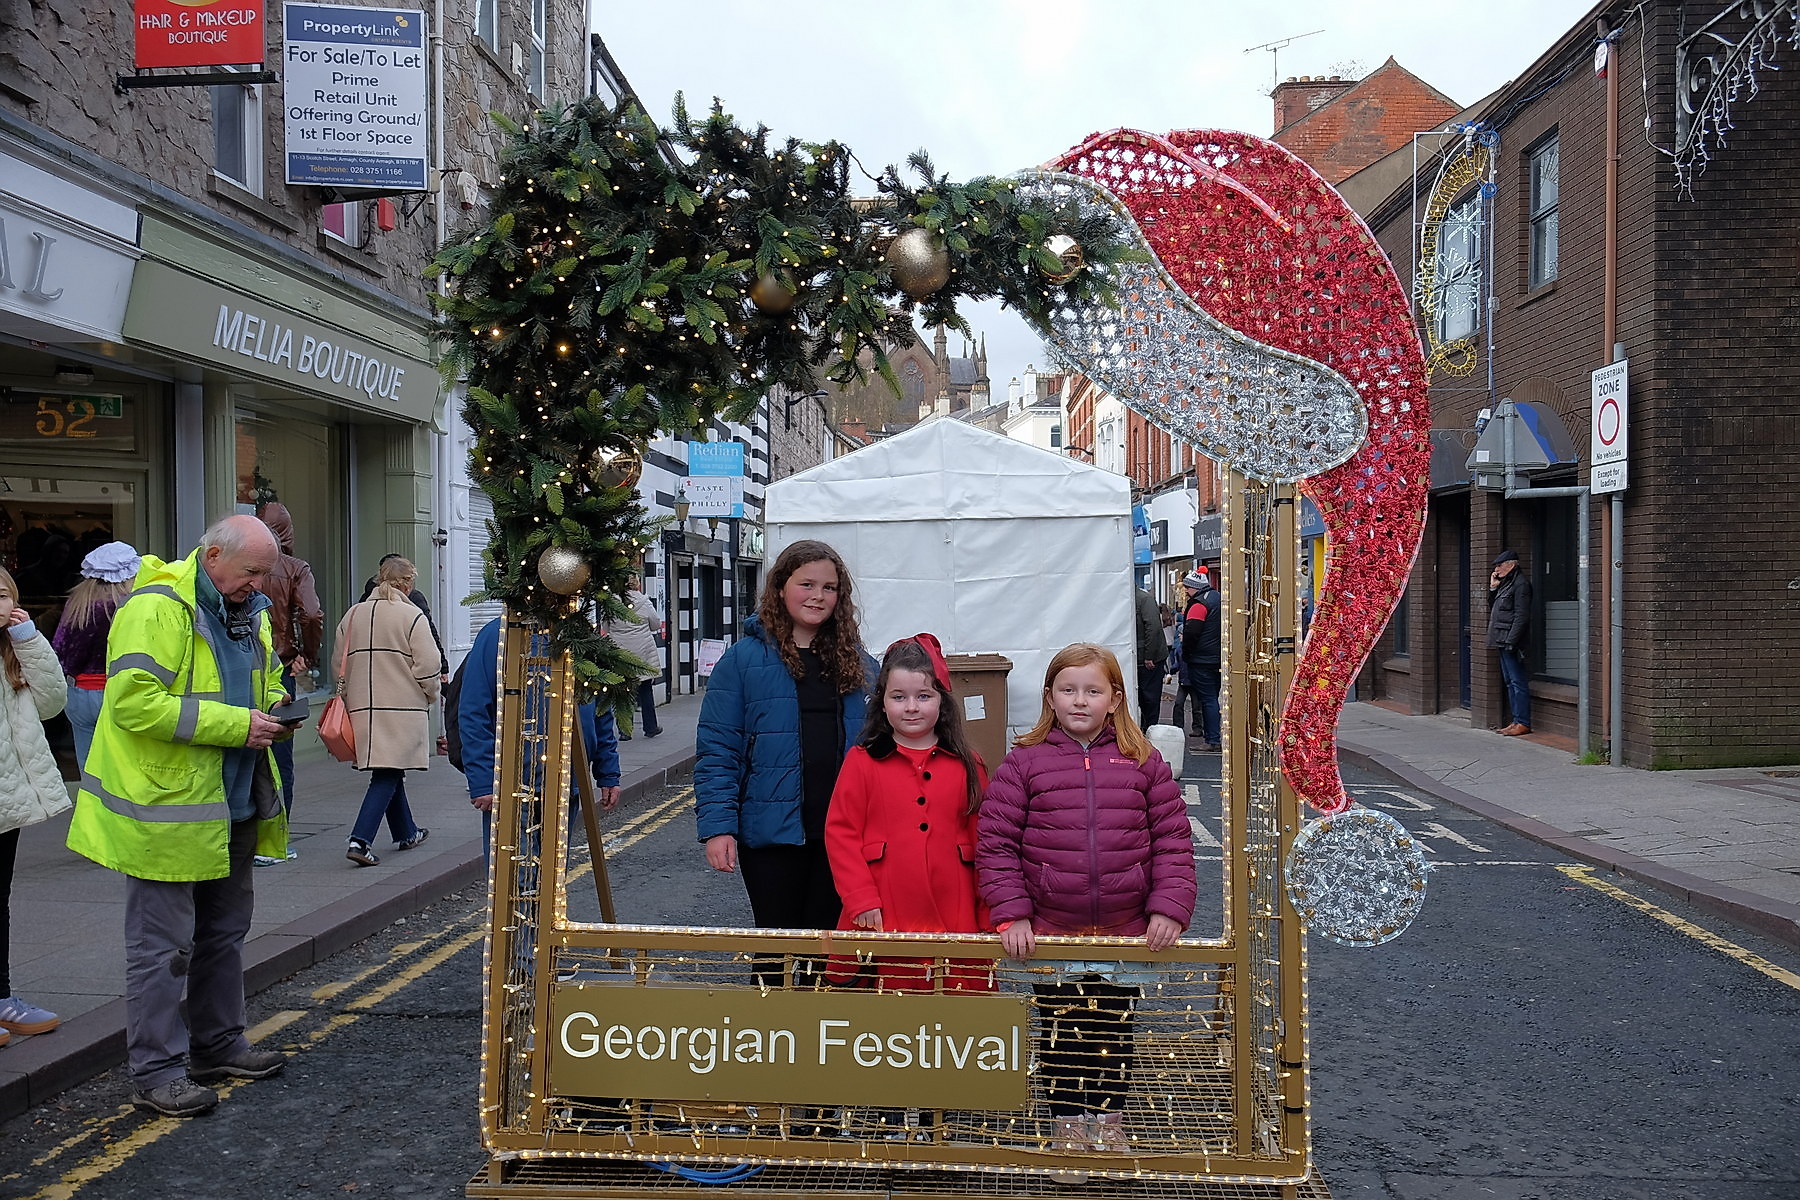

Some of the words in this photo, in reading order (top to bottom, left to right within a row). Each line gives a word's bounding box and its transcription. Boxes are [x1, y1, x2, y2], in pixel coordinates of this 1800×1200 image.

[140, 13, 173, 29] HAIR
[179, 12, 190, 28] &
[196, 9, 256, 27] MAKEUP
[168, 29, 228, 45] BOUTIQUE
[303, 20, 401, 38] PropertyLink
[288, 46, 318, 63] For
[323, 47, 388, 66] Sale/To
[393, 51, 421, 69] Let
[332, 72, 379, 87] Prime
[314, 90, 360, 105] Retail
[365, 92, 398, 107] Unit
[289, 107, 353, 125] Offering
[358, 110, 421, 127] Ground/
[300, 128, 318, 140] 1st
[322, 128, 362, 142] Floor
[367, 130, 413, 146] Space
[308, 164, 348, 174] Telephone:
[350, 166, 364, 174] 028
[365, 167, 383, 175] 3751
[213, 304, 294, 369] MELIA
[297, 335, 405, 402] BOUTIQUE
[1594, 366, 1625, 382] PEDESTRIAN
[1598, 379, 1620, 397] ZONE
[36, 397, 97, 437] 52
[693, 443, 739, 457] Redian
[1603, 449, 1621, 460] vehicles
[1598, 469, 1612, 479] Except
[1600, 478, 1616, 488] loading
[705, 492, 713, 501] of
[560, 1011, 796, 1074] Georgian
[818, 1019, 1020, 1072] Festival
